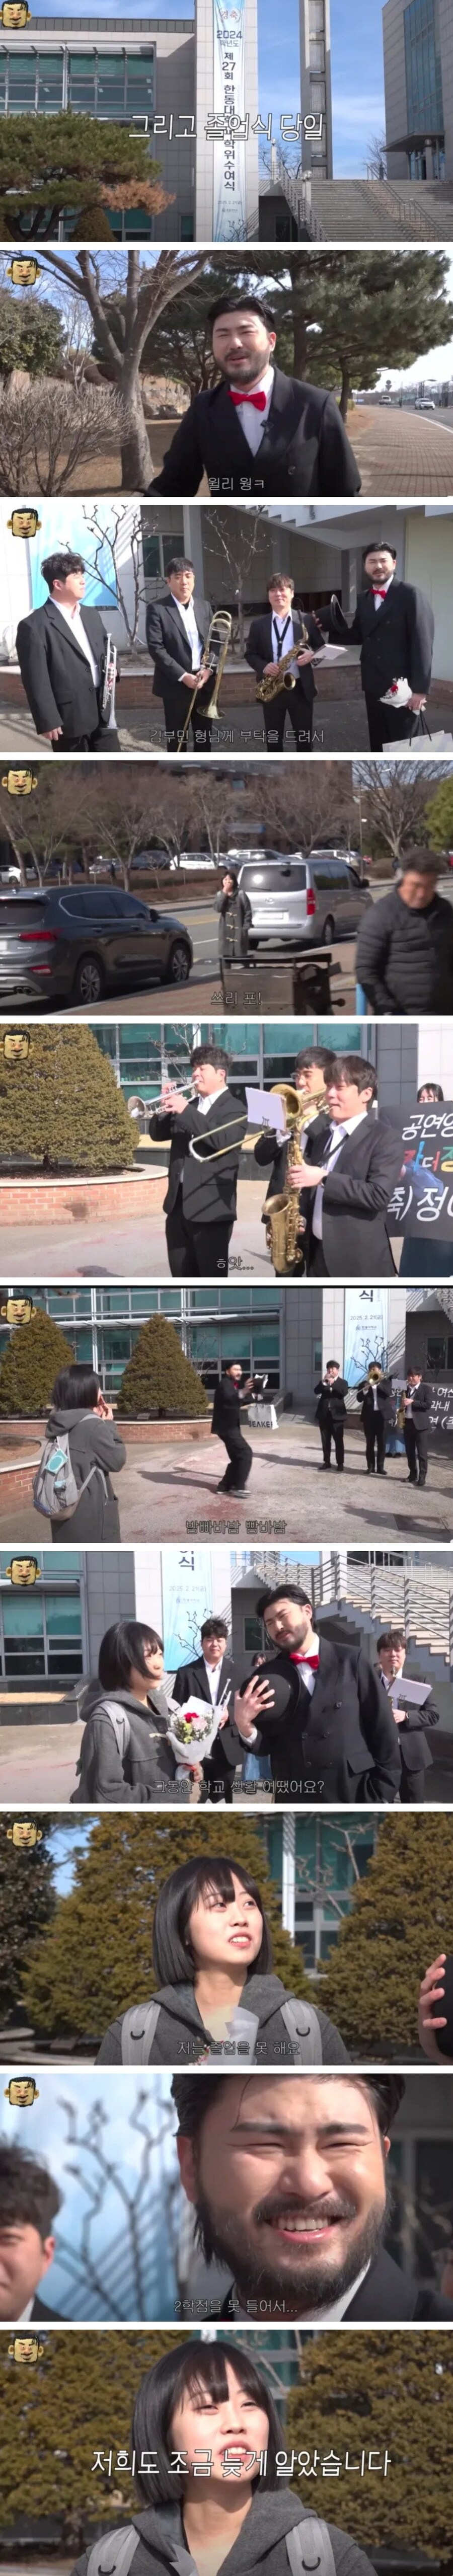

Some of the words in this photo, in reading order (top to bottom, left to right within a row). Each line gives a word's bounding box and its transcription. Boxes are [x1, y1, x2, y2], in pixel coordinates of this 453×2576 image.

[221, 10, 238, 20] 경축
[217, 30, 242, 39] 2024
[178, 1556, 194, 1571] 식
